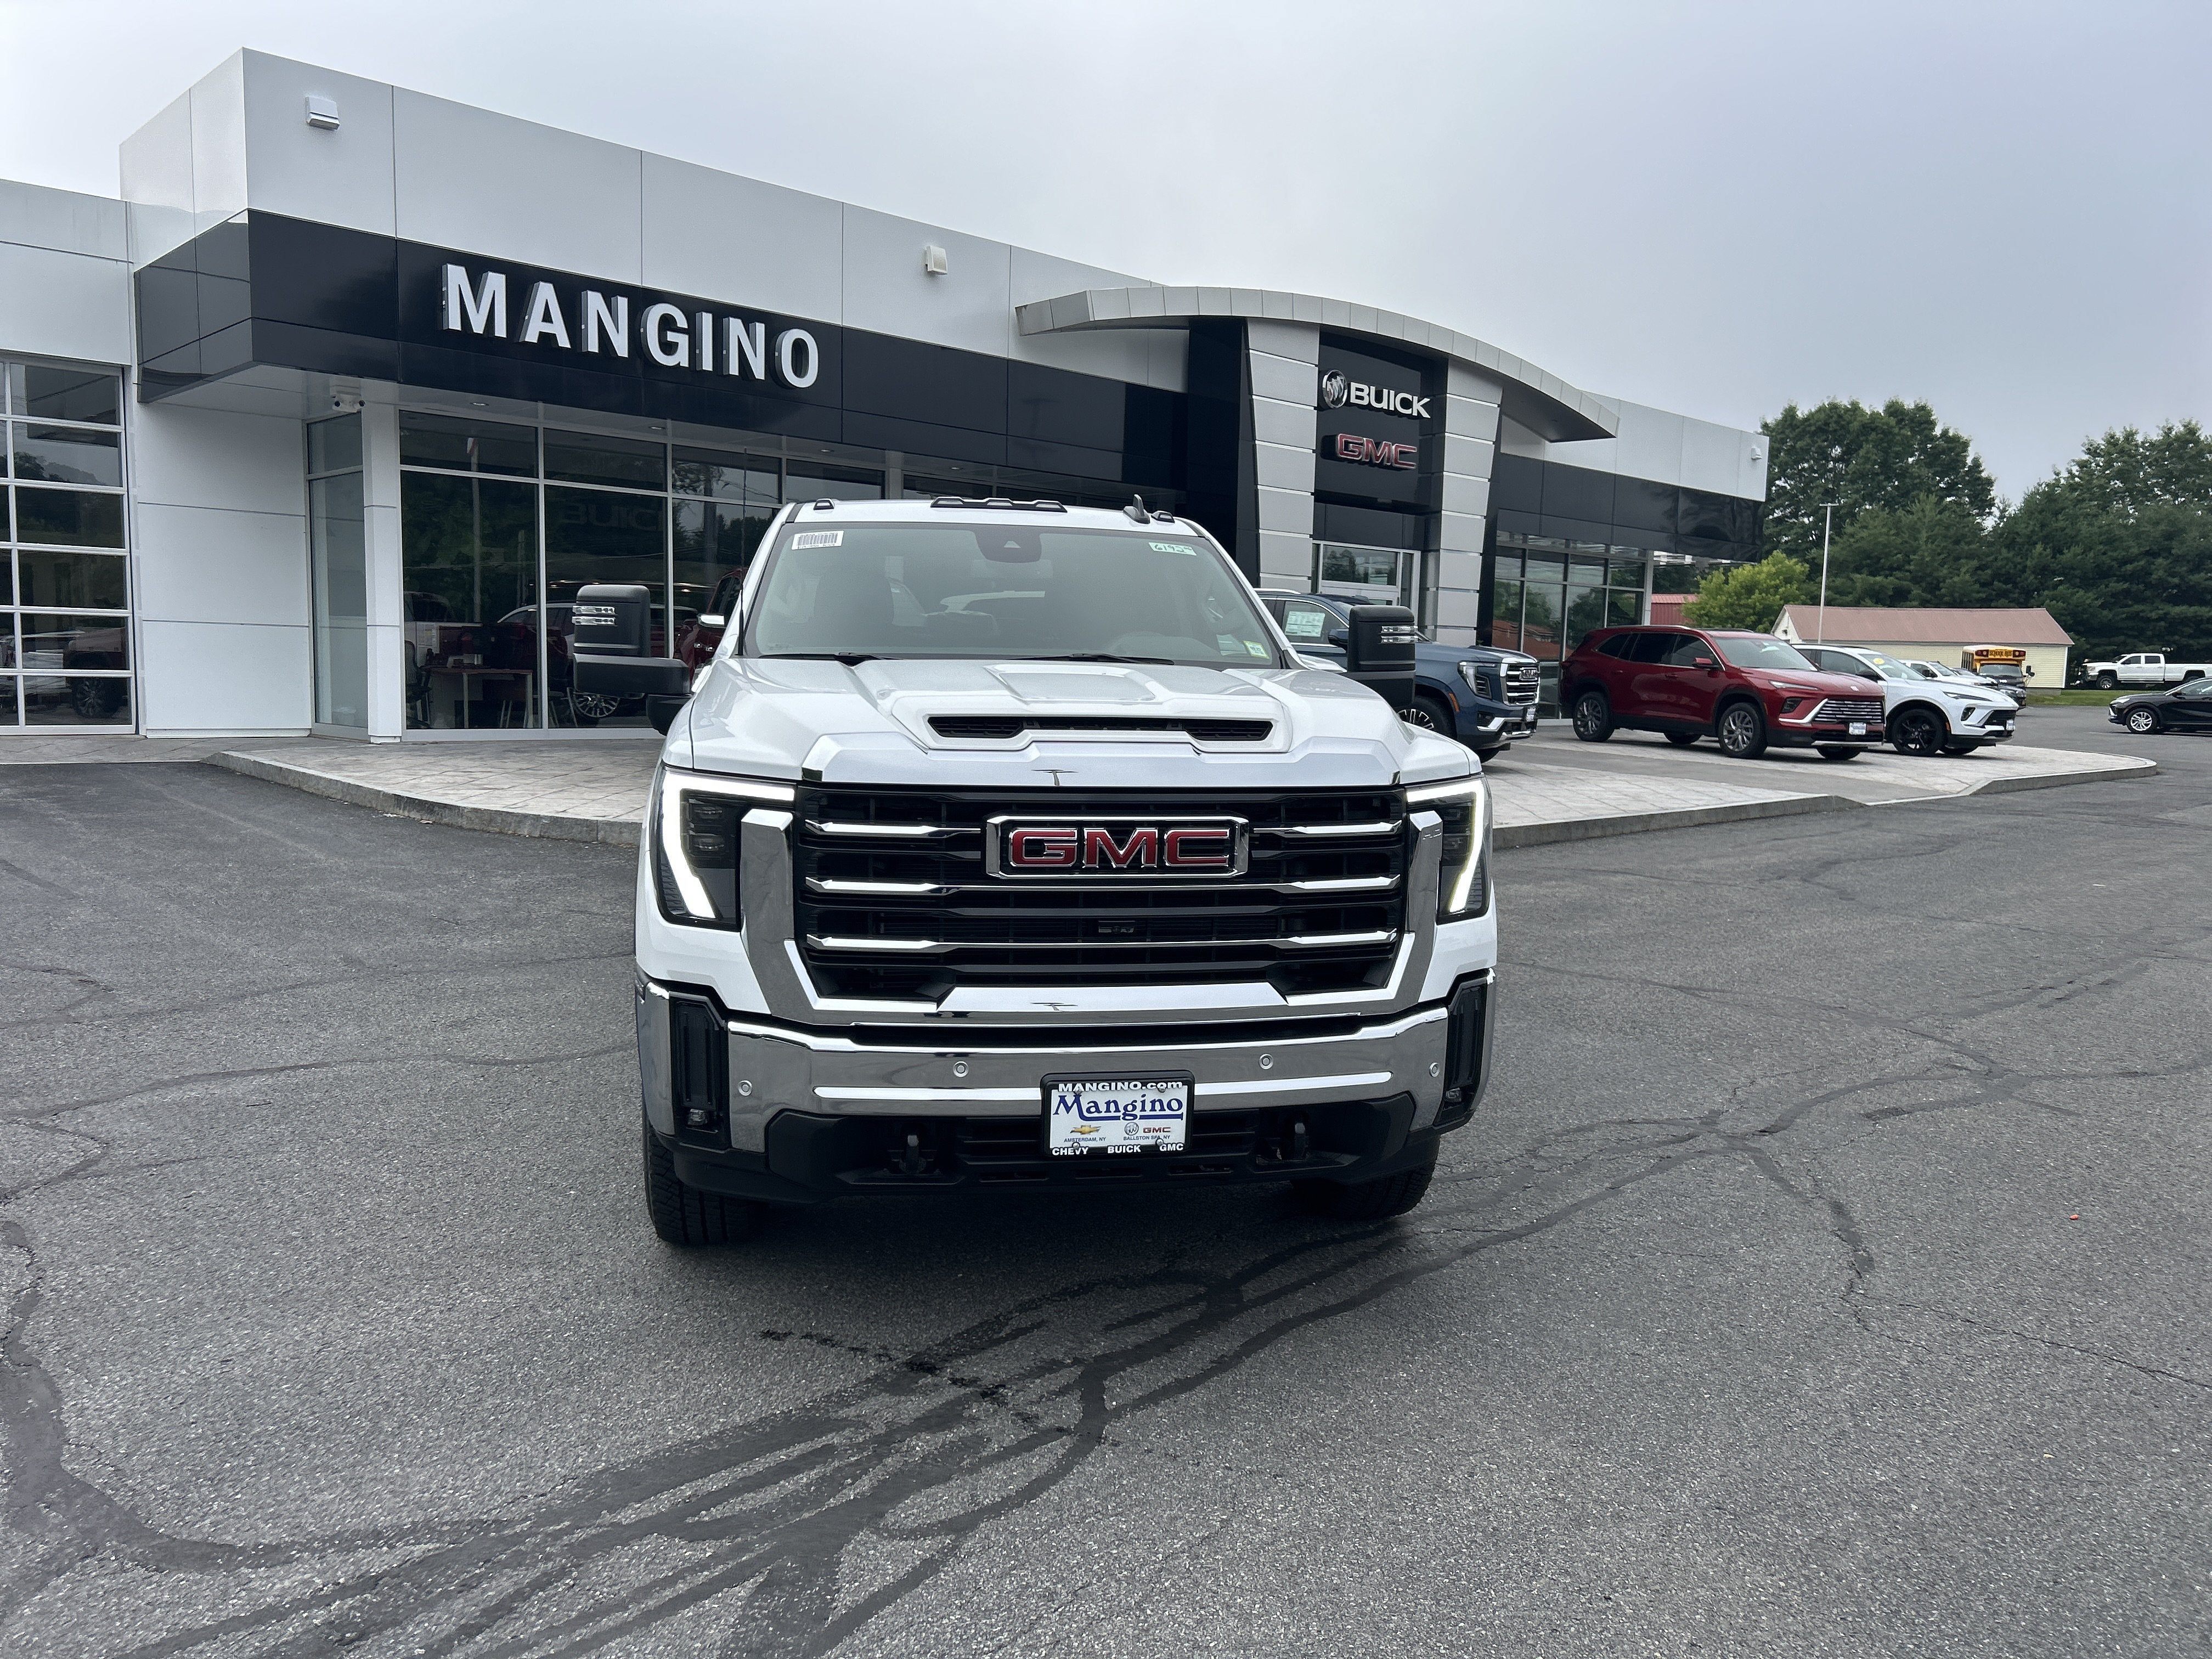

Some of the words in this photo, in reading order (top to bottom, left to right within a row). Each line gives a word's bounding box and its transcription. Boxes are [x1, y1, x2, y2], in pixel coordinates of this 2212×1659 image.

[442, 262, 819, 388] MANGINO
[1350, 382, 1431, 419] BUICK
[1338, 433, 1417, 469] GMC
[1008, 828, 1230, 868] GMC
[1058, 1081, 1183, 1092] MANGINO.com
[1053, 1094, 1183, 1121] Mangino
[1052, 1147, 1089, 1156] CHEVY
[1107, 1144, 1141, 1153] BUICK
[1159, 1143, 1184, 1152] GMC
